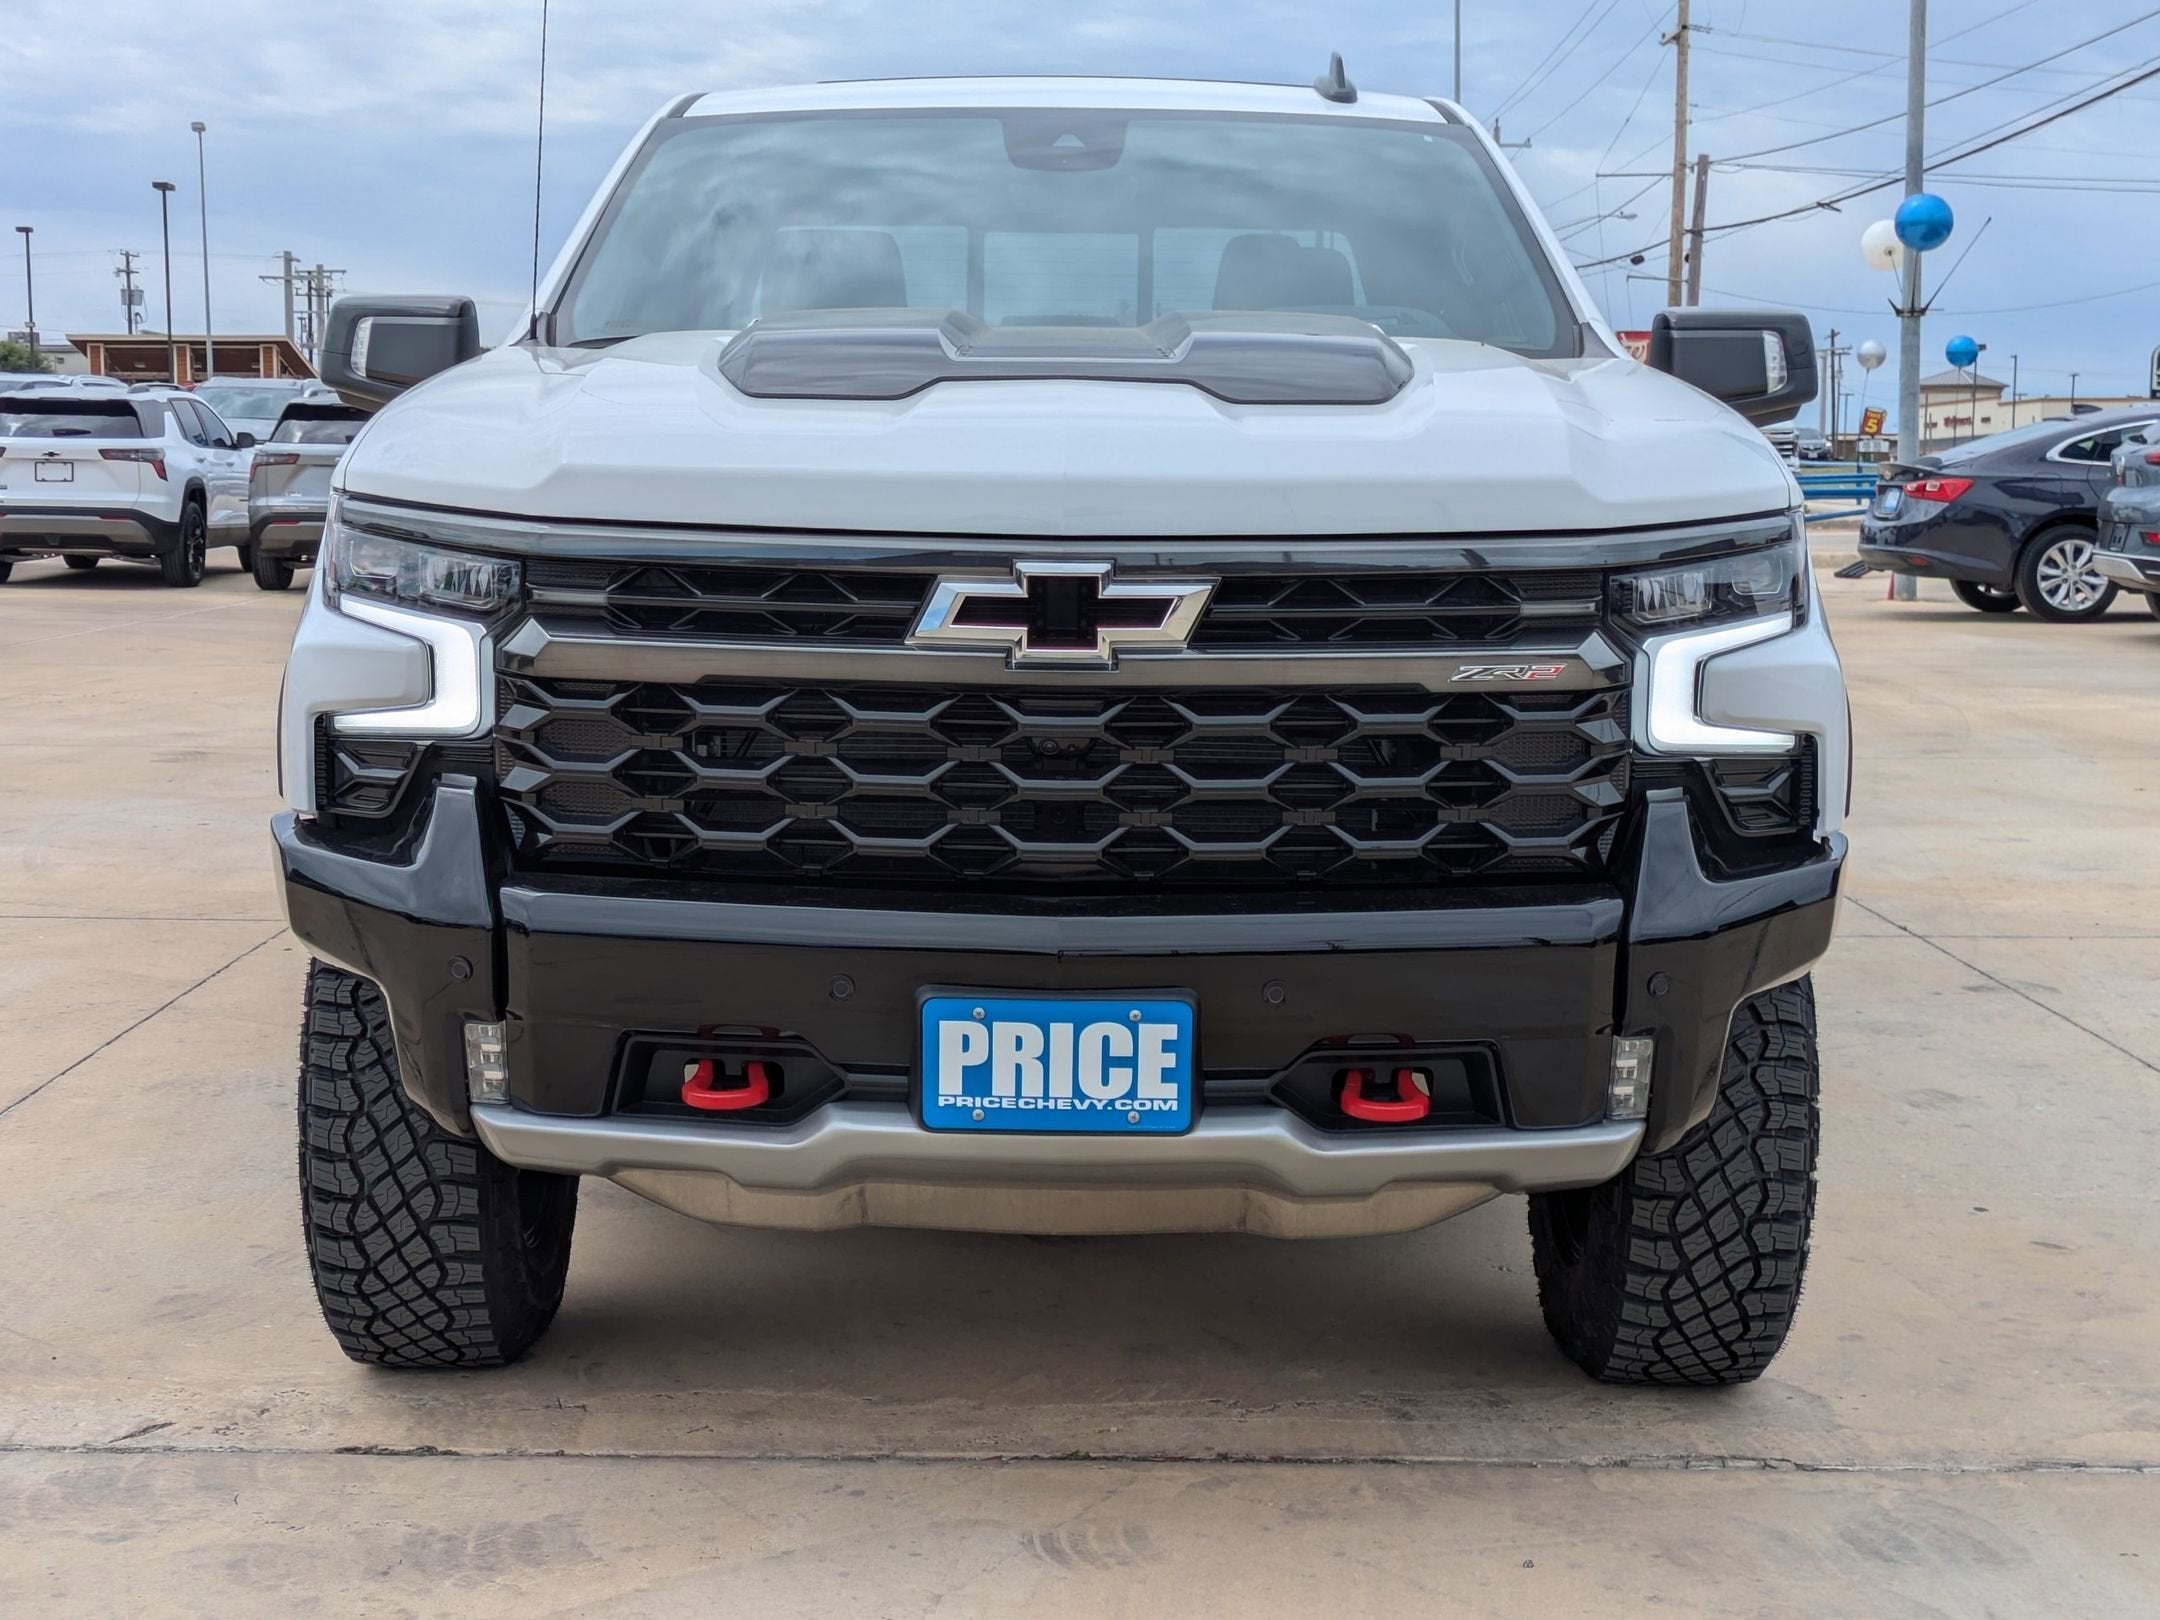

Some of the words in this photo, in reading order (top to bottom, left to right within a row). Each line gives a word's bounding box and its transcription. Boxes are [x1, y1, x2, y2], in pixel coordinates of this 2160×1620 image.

[1451, 664, 1567, 681] ZR2
[939, 1021, 1178, 1100] PRICE
[938, 1096, 1178, 1111] PRICECHEVY.COM
